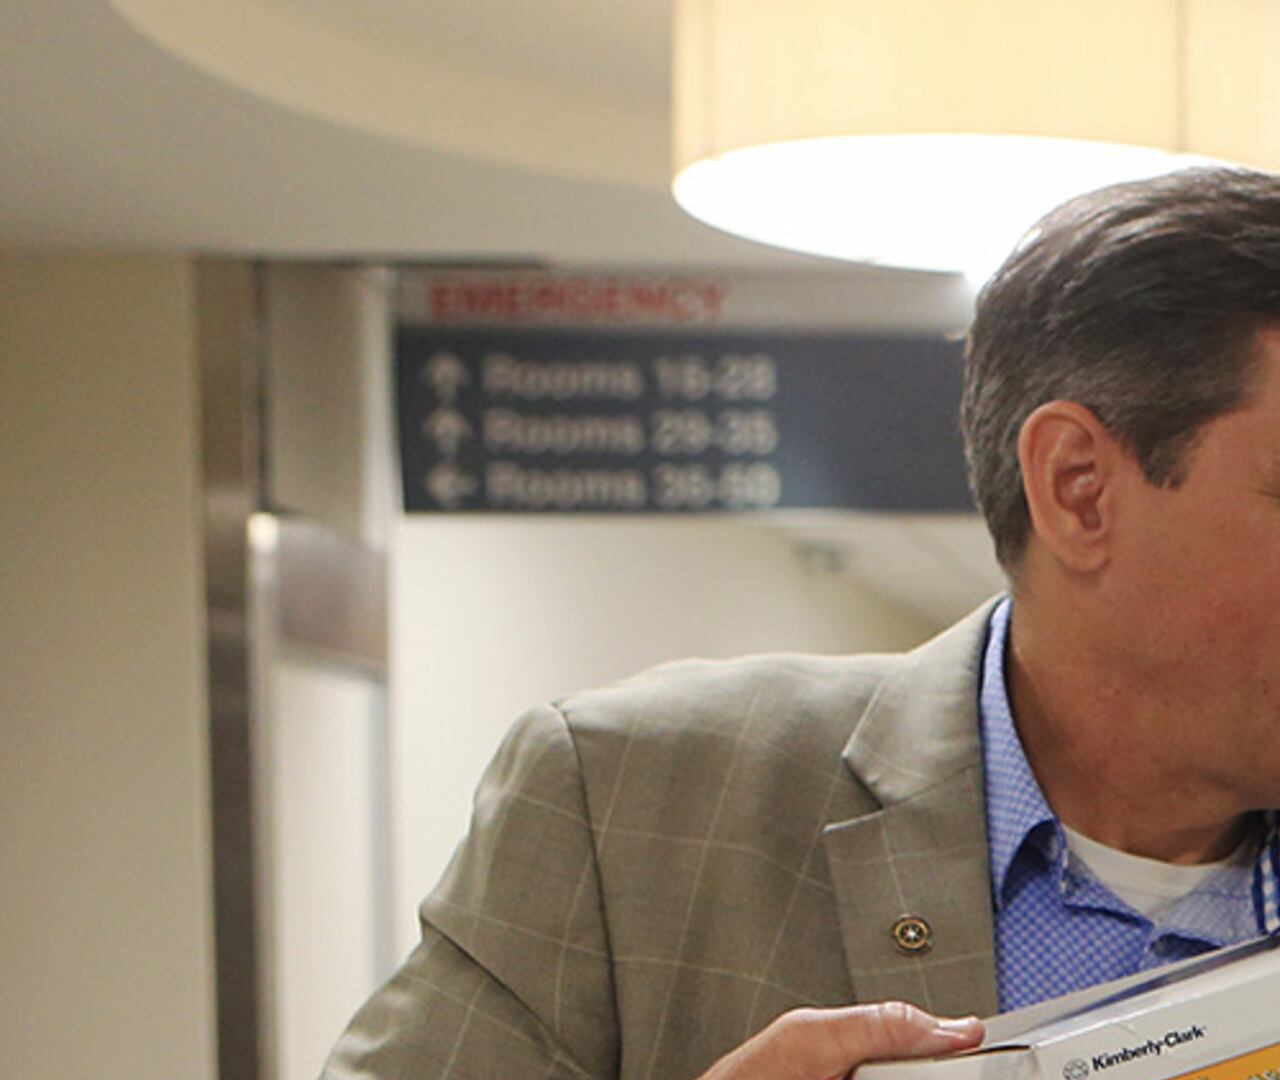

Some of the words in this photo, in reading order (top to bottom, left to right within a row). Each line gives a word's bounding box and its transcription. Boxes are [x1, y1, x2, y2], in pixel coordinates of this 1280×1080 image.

[428, 281, 730, 320] EMERGENCY
[482, 354, 644, 400] Rooms
[482, 409, 646, 455] Rooms
[484, 462, 647, 507] Rooms
[1092, 1025, 1204, 1071] Kimberly-Clark
